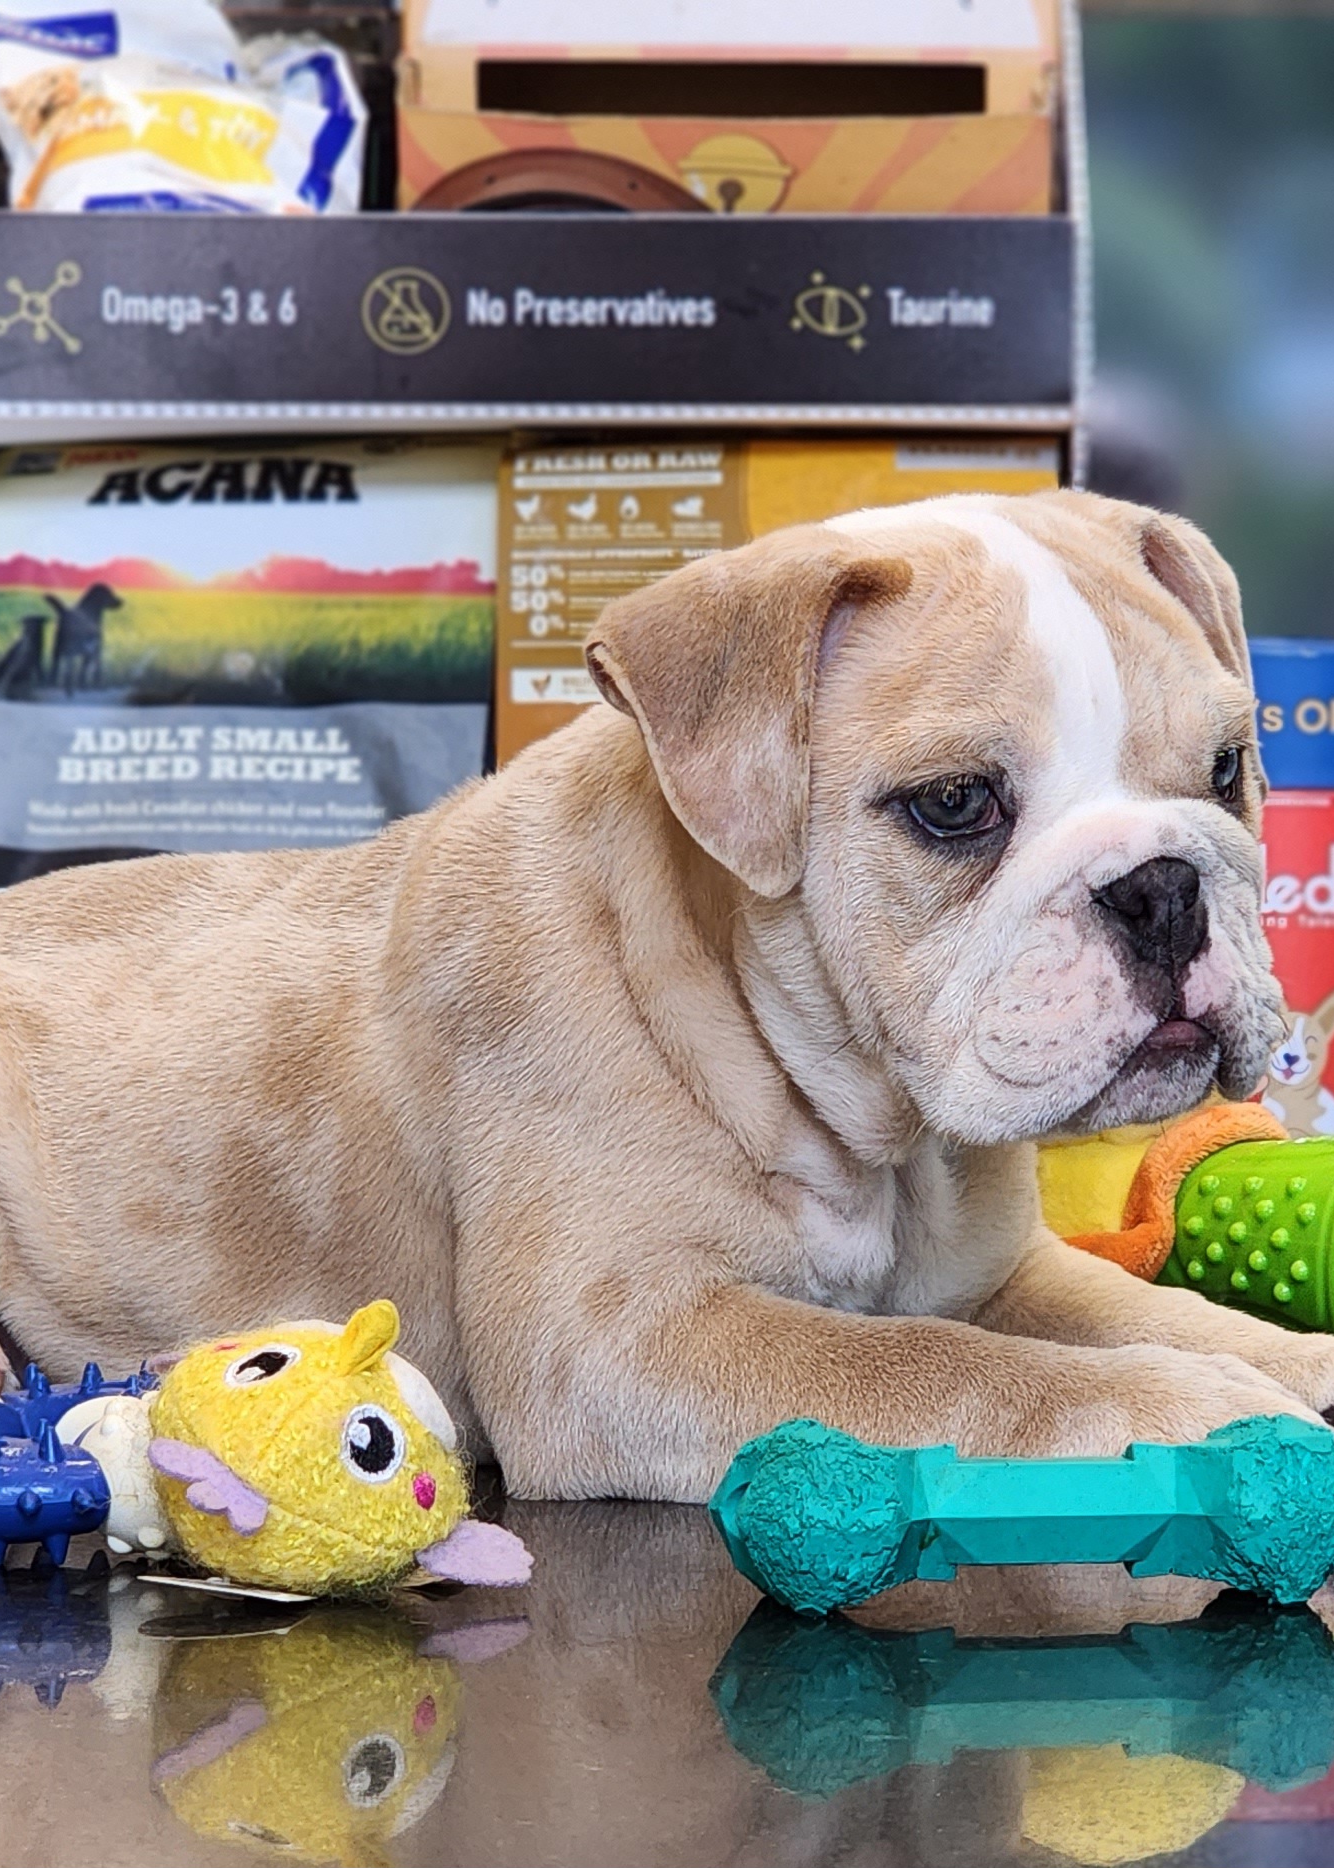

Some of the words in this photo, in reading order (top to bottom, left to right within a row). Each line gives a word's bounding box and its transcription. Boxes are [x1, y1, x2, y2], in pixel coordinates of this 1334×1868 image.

[101, 287, 239, 333] Omega-3
[247, 288, 269, 325] &
[278, 287, 298, 325] 6
[467, 289, 505, 326] No
[514, 288, 716, 327] Preservatives
[887, 288, 995, 327] Taurine
[87, 457, 361, 505] ACANA
[71, 726, 205, 754] ADULT
[212, 726, 351, 755] SMALL
[58, 756, 201, 785] BREED
[209, 756, 362, 785] RECIPE
